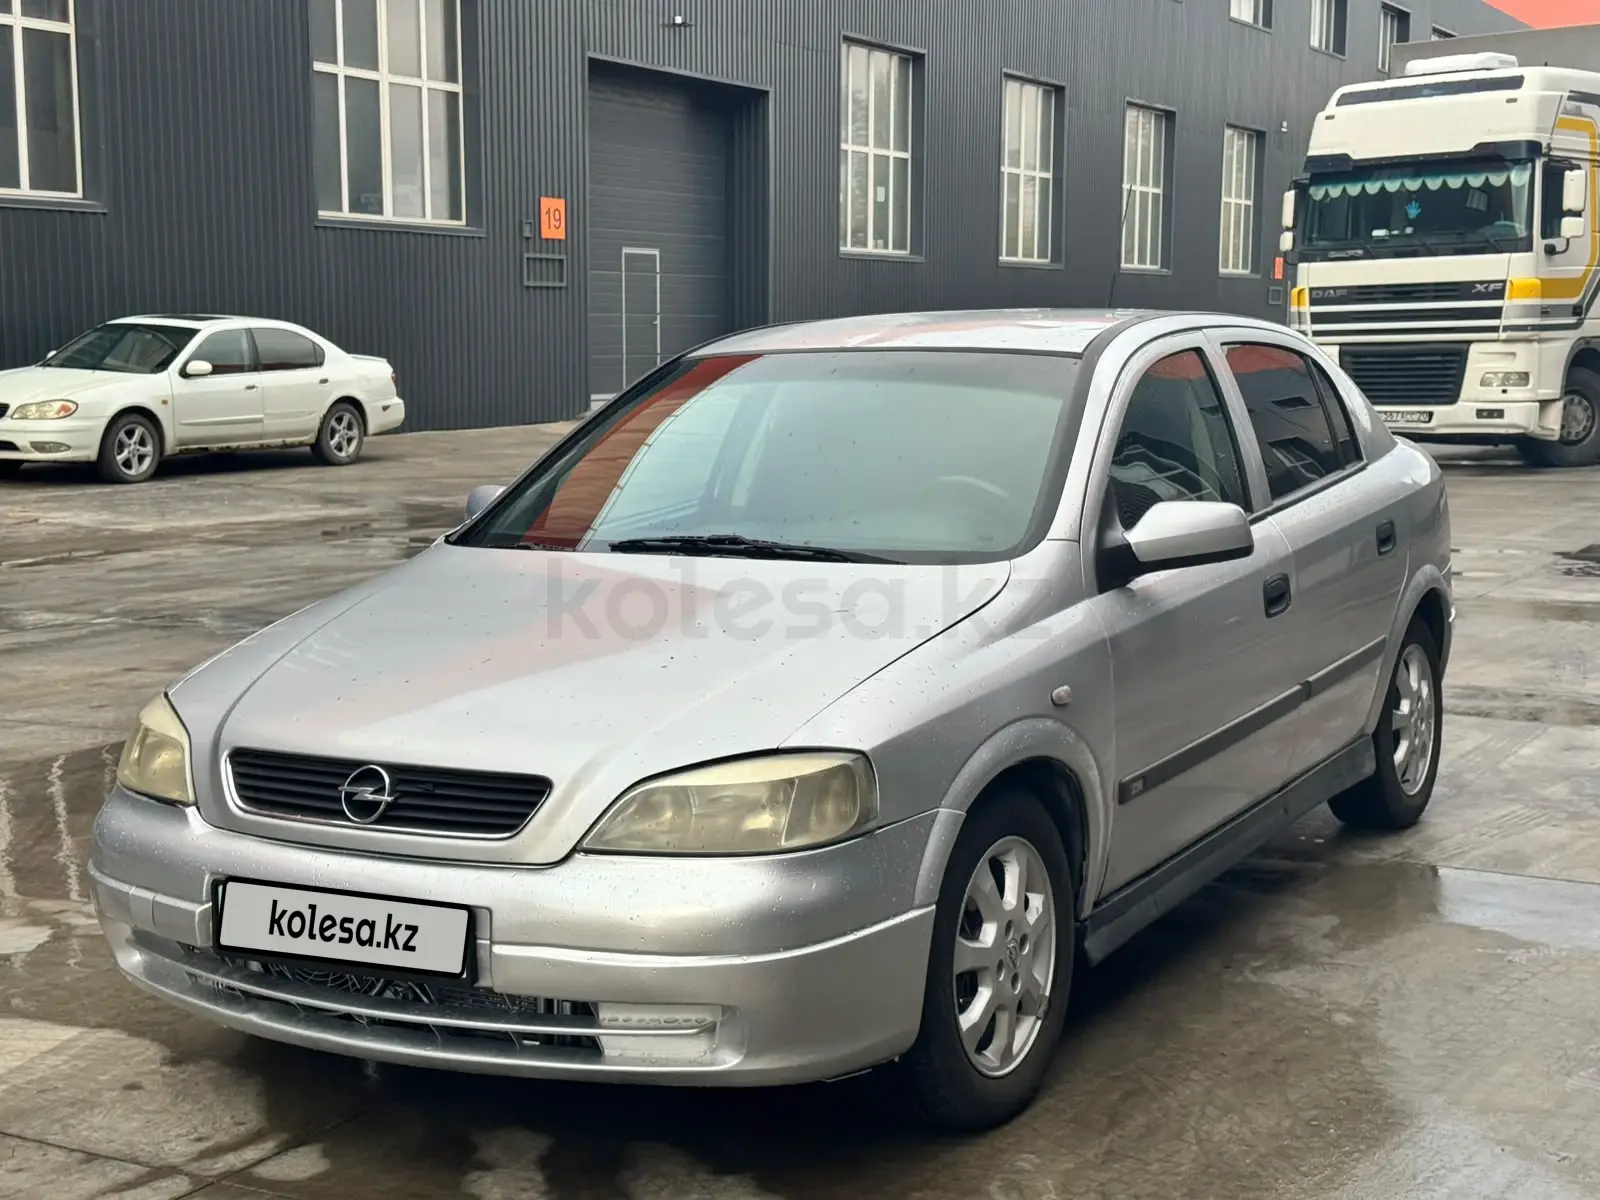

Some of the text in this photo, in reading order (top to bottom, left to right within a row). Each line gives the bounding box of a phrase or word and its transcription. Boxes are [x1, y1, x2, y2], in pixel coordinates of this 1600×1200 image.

[544, 207, 562, 230] 19
[1311, 288, 1348, 298] DAF
[1471, 283, 1504, 293] XF
